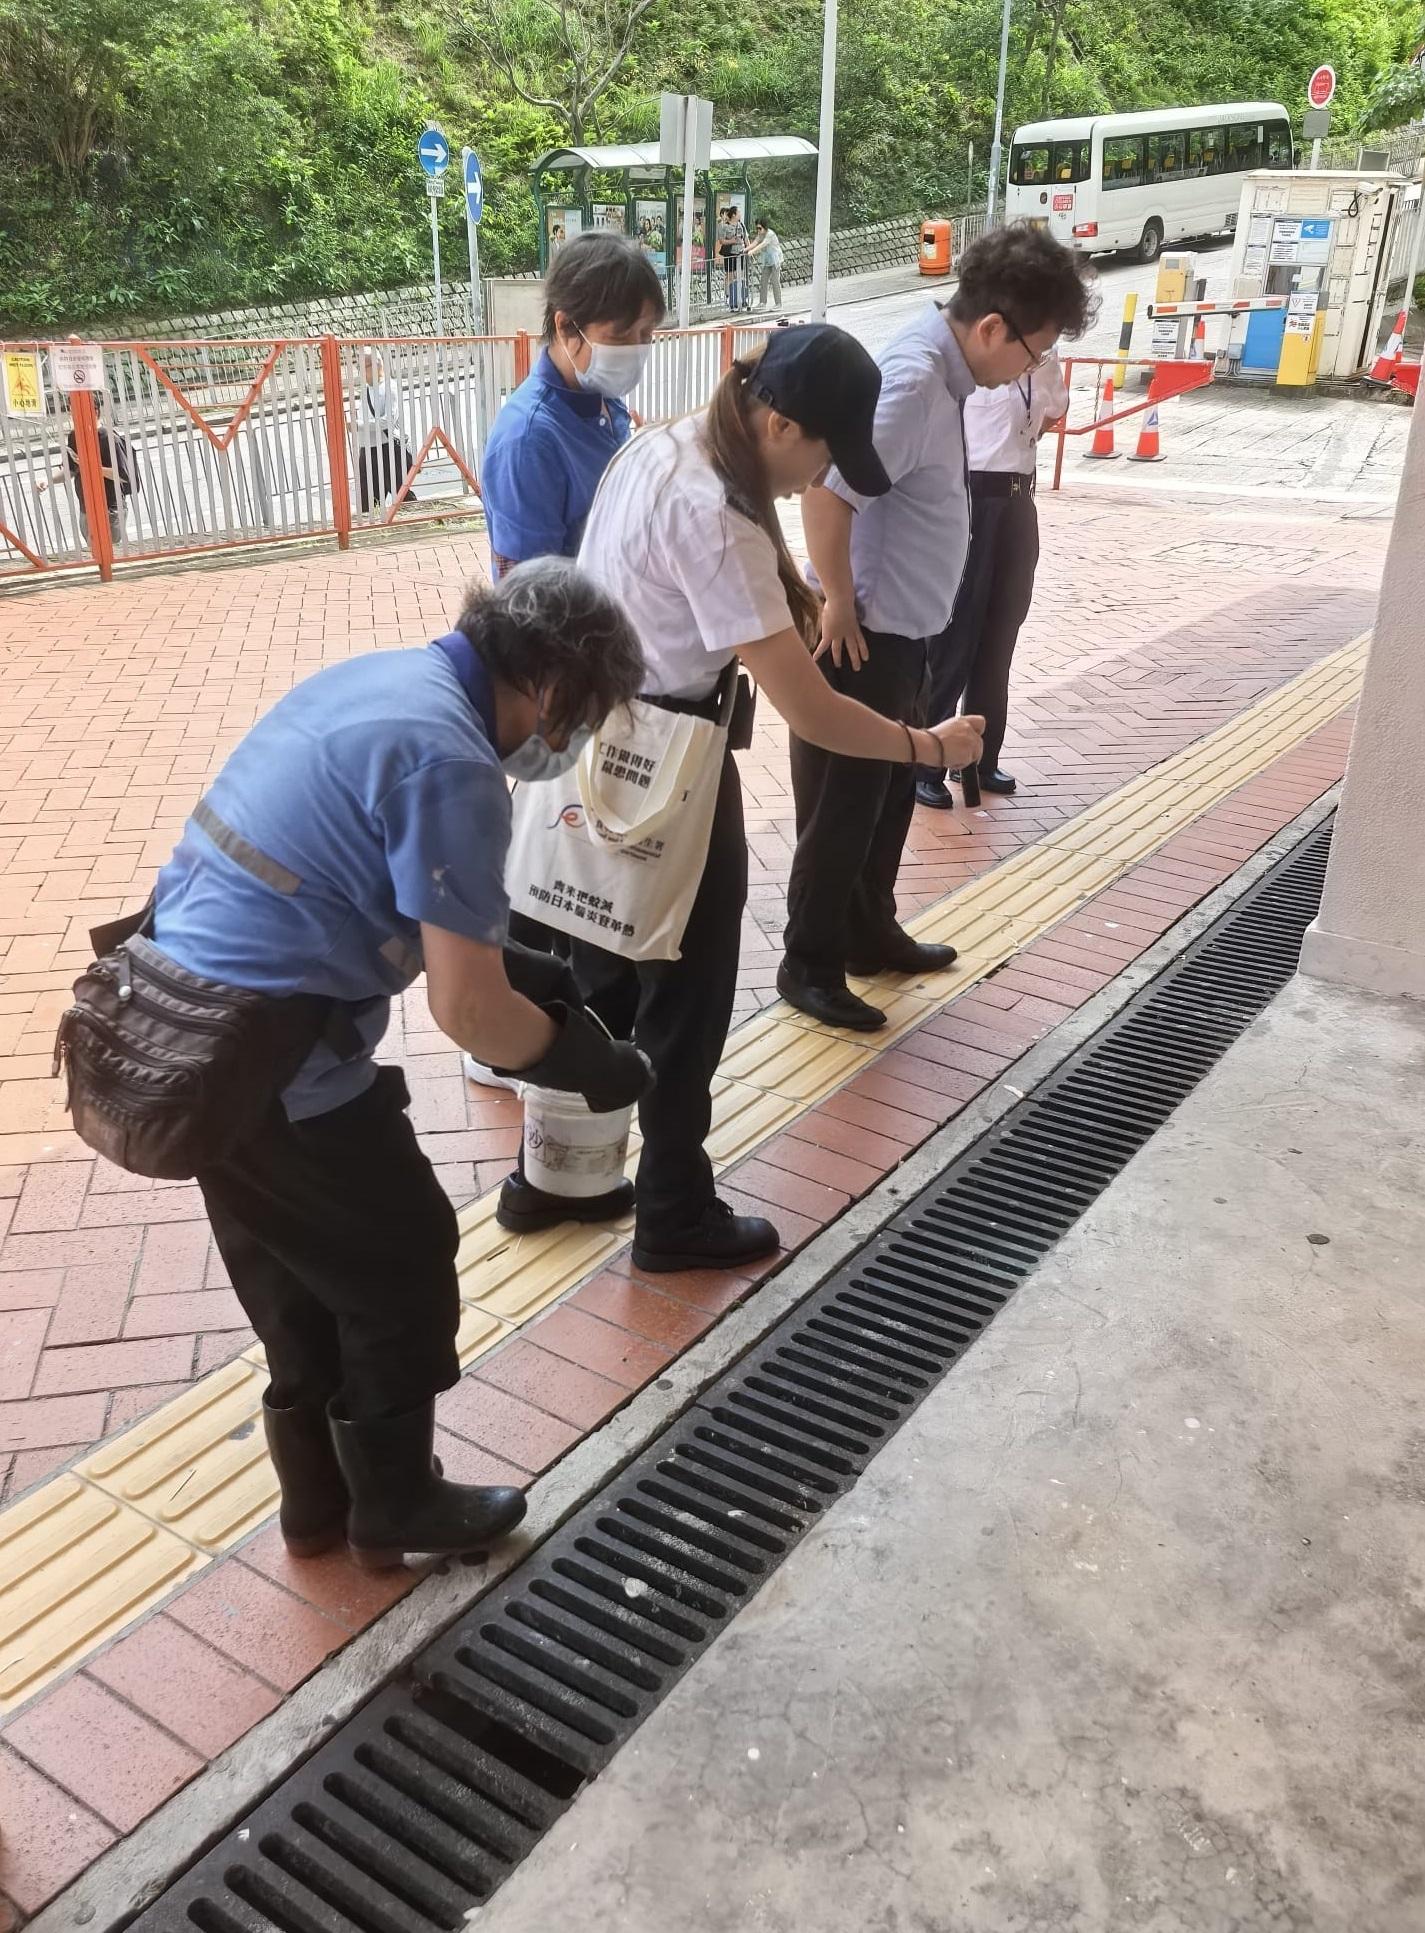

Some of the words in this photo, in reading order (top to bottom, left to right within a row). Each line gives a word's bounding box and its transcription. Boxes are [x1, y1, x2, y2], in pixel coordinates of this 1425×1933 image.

[528, 883, 635, 937] 預防日本腦炎登革熱
[552, 879, 614, 914] 齊來把蚊滅
